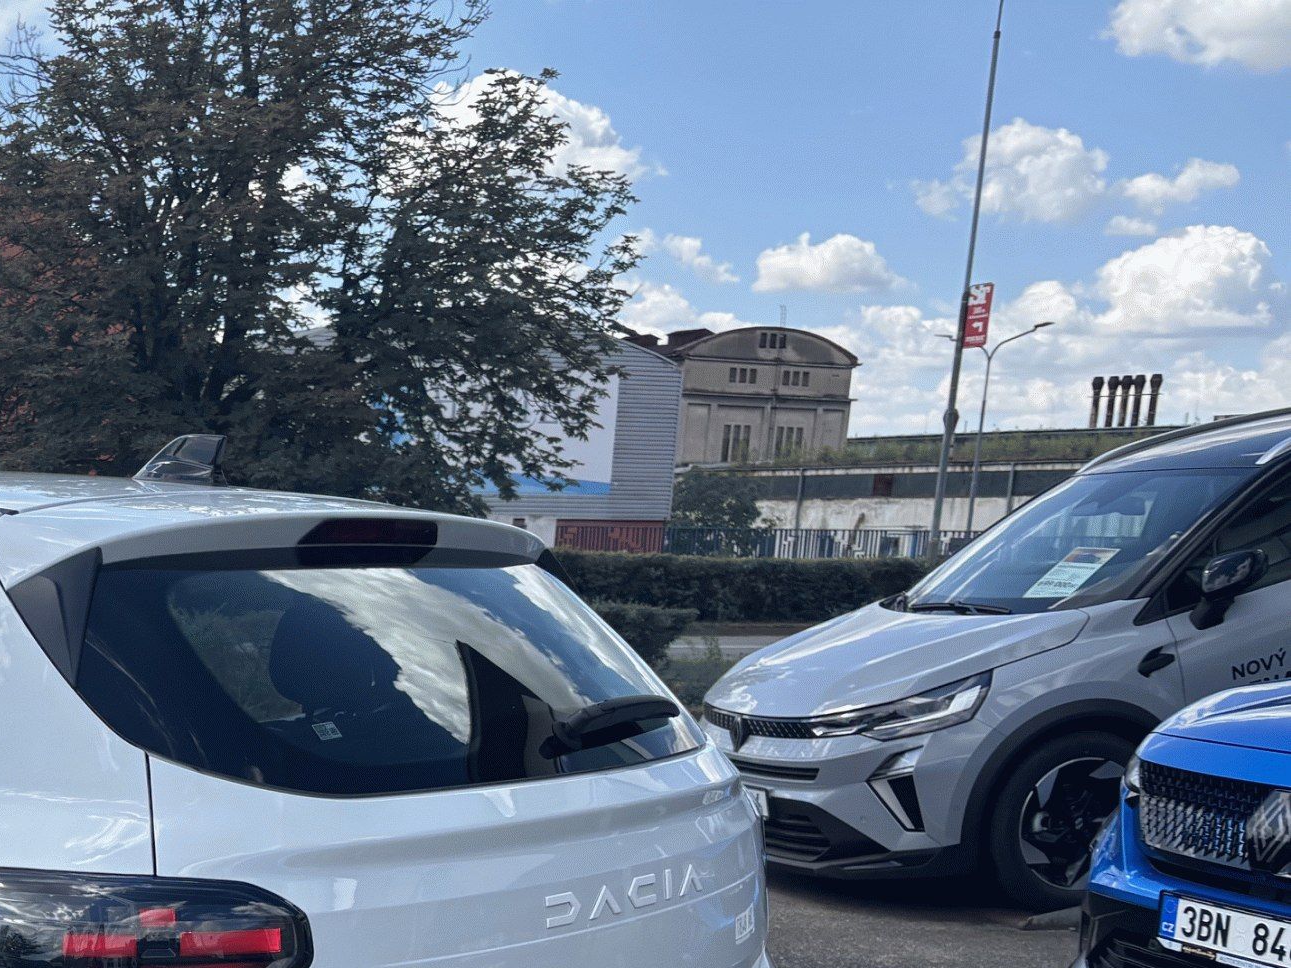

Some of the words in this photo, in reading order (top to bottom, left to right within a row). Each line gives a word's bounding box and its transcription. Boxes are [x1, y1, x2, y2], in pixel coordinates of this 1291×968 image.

[1231, 647, 1287, 680] NOVÝ
[544, 863, 704, 930] DACIA
[1161, 921, 1175, 933] CZ
[1181, 905, 1232, 948] 3BN
[1251, 922, 1291, 962] 84
